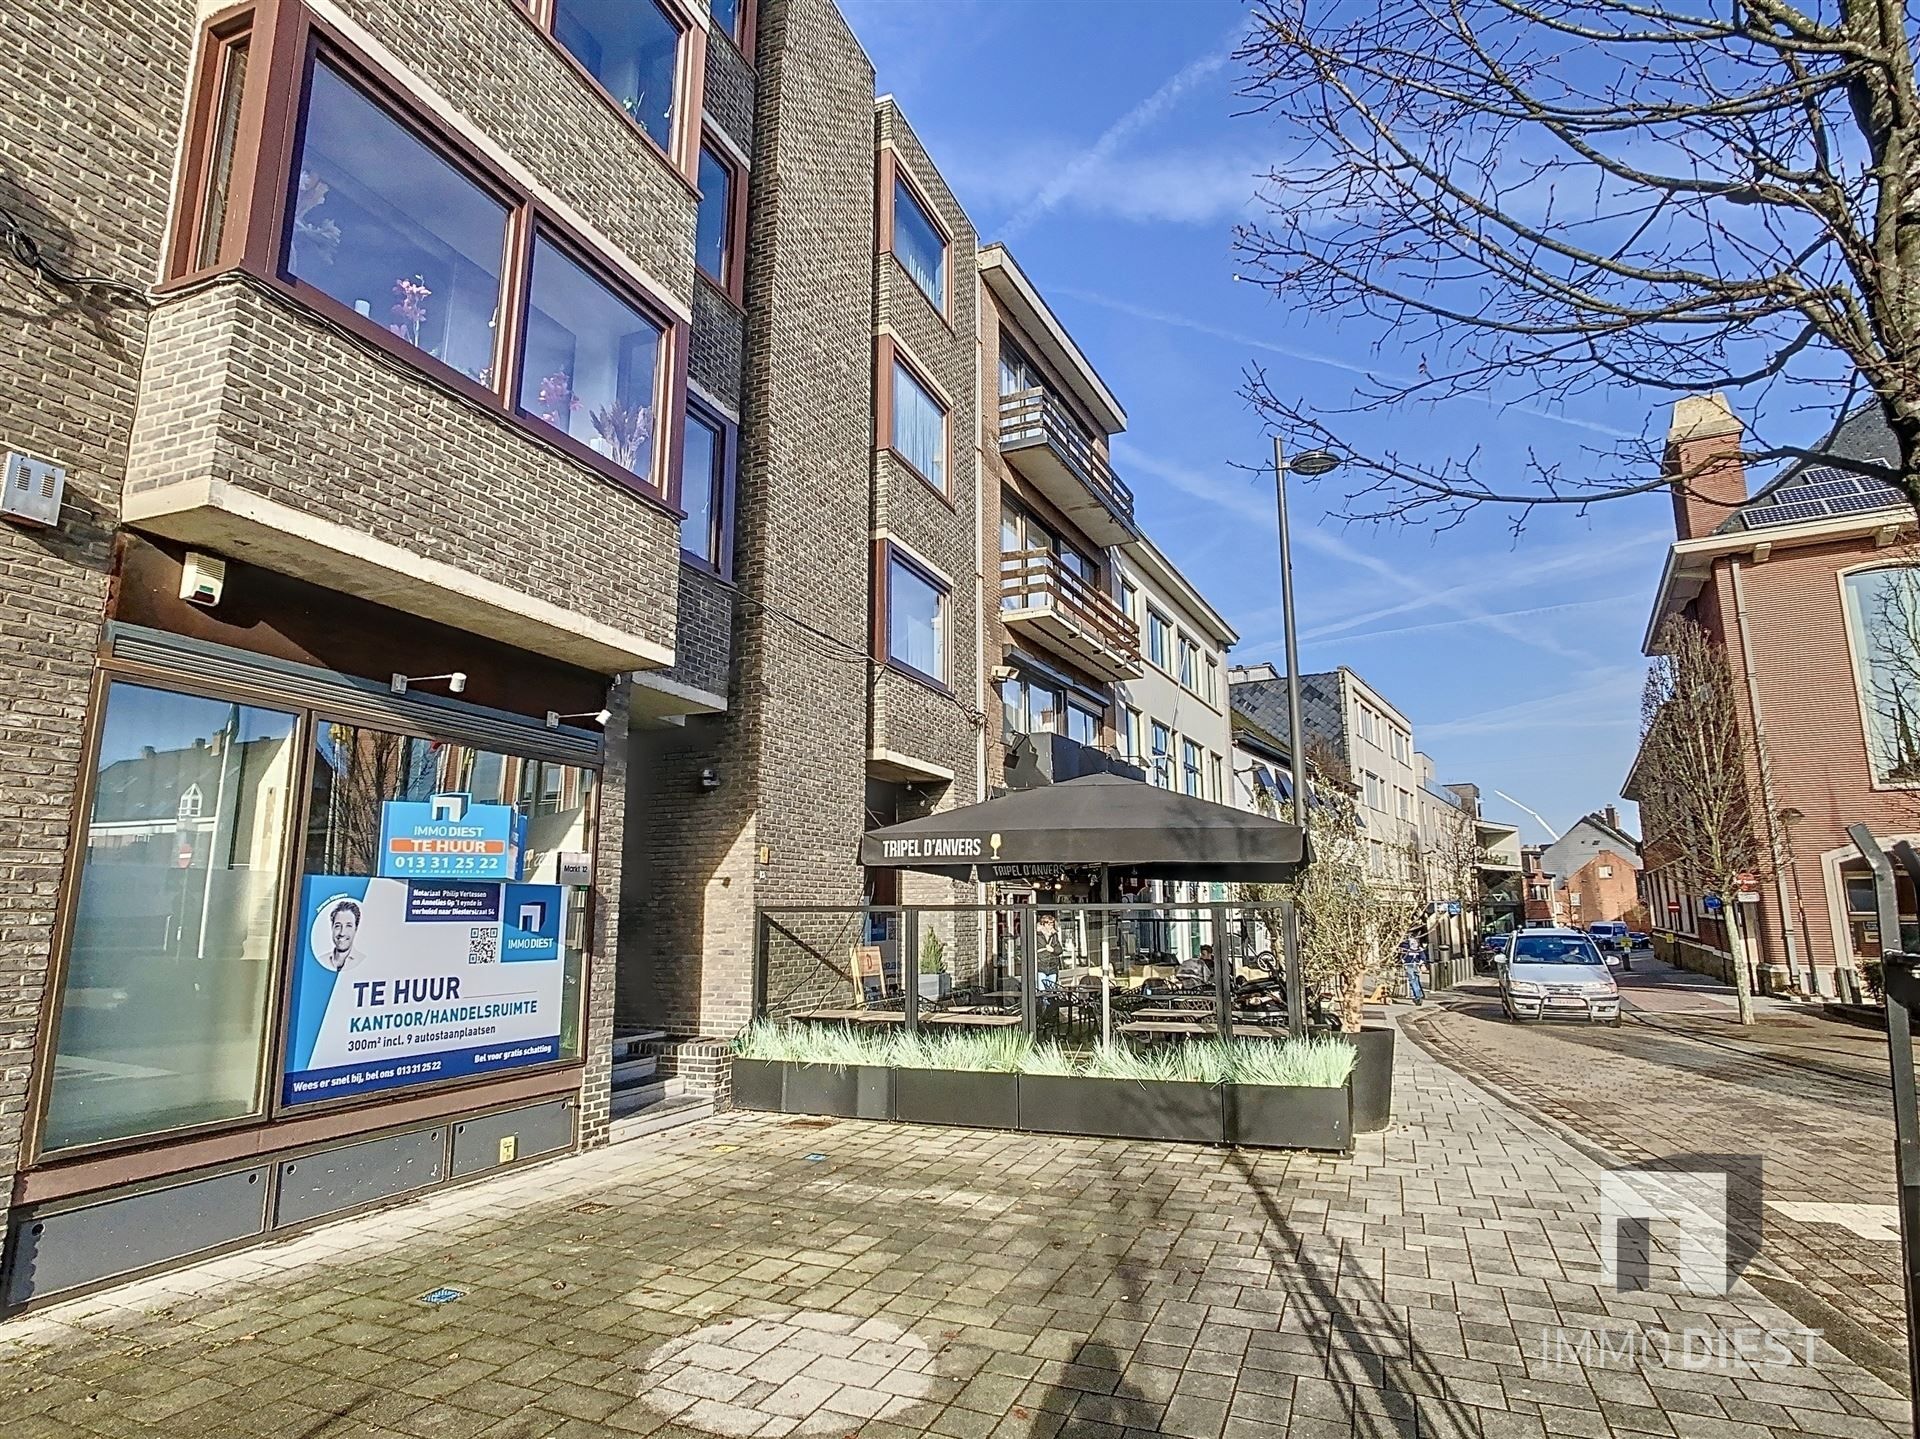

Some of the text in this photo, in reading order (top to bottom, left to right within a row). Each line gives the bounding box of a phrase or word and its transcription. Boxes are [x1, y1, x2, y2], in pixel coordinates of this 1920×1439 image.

[411, 839, 486, 853] TE HUUR
[882, 837, 982, 858] TRIPEL D'ANVERS
[395, 856, 498, 869] 013 31 25 22
[564, 865, 580, 873] Markt
[992, 865, 1021, 877] TRIPEL
[353, 976, 460, 1008] TE HUUR
[350, 1000, 538, 1033] KANTOOR/HANDELSRUIMTE
[348, 1025, 496, 1052] 300m² incl. 9 autostaanplaatsen
[474, 1044, 552, 1063] Bel voor gratis schatting
[293, 1080, 319, 1092] Wees
[319, 1079, 331, 1088] er
[331, 1074, 350, 1086] snel
[351, 1072, 364, 1084] bij,
[365, 1070, 379, 1080] bel
[379, 1068, 394, 1078] ons
